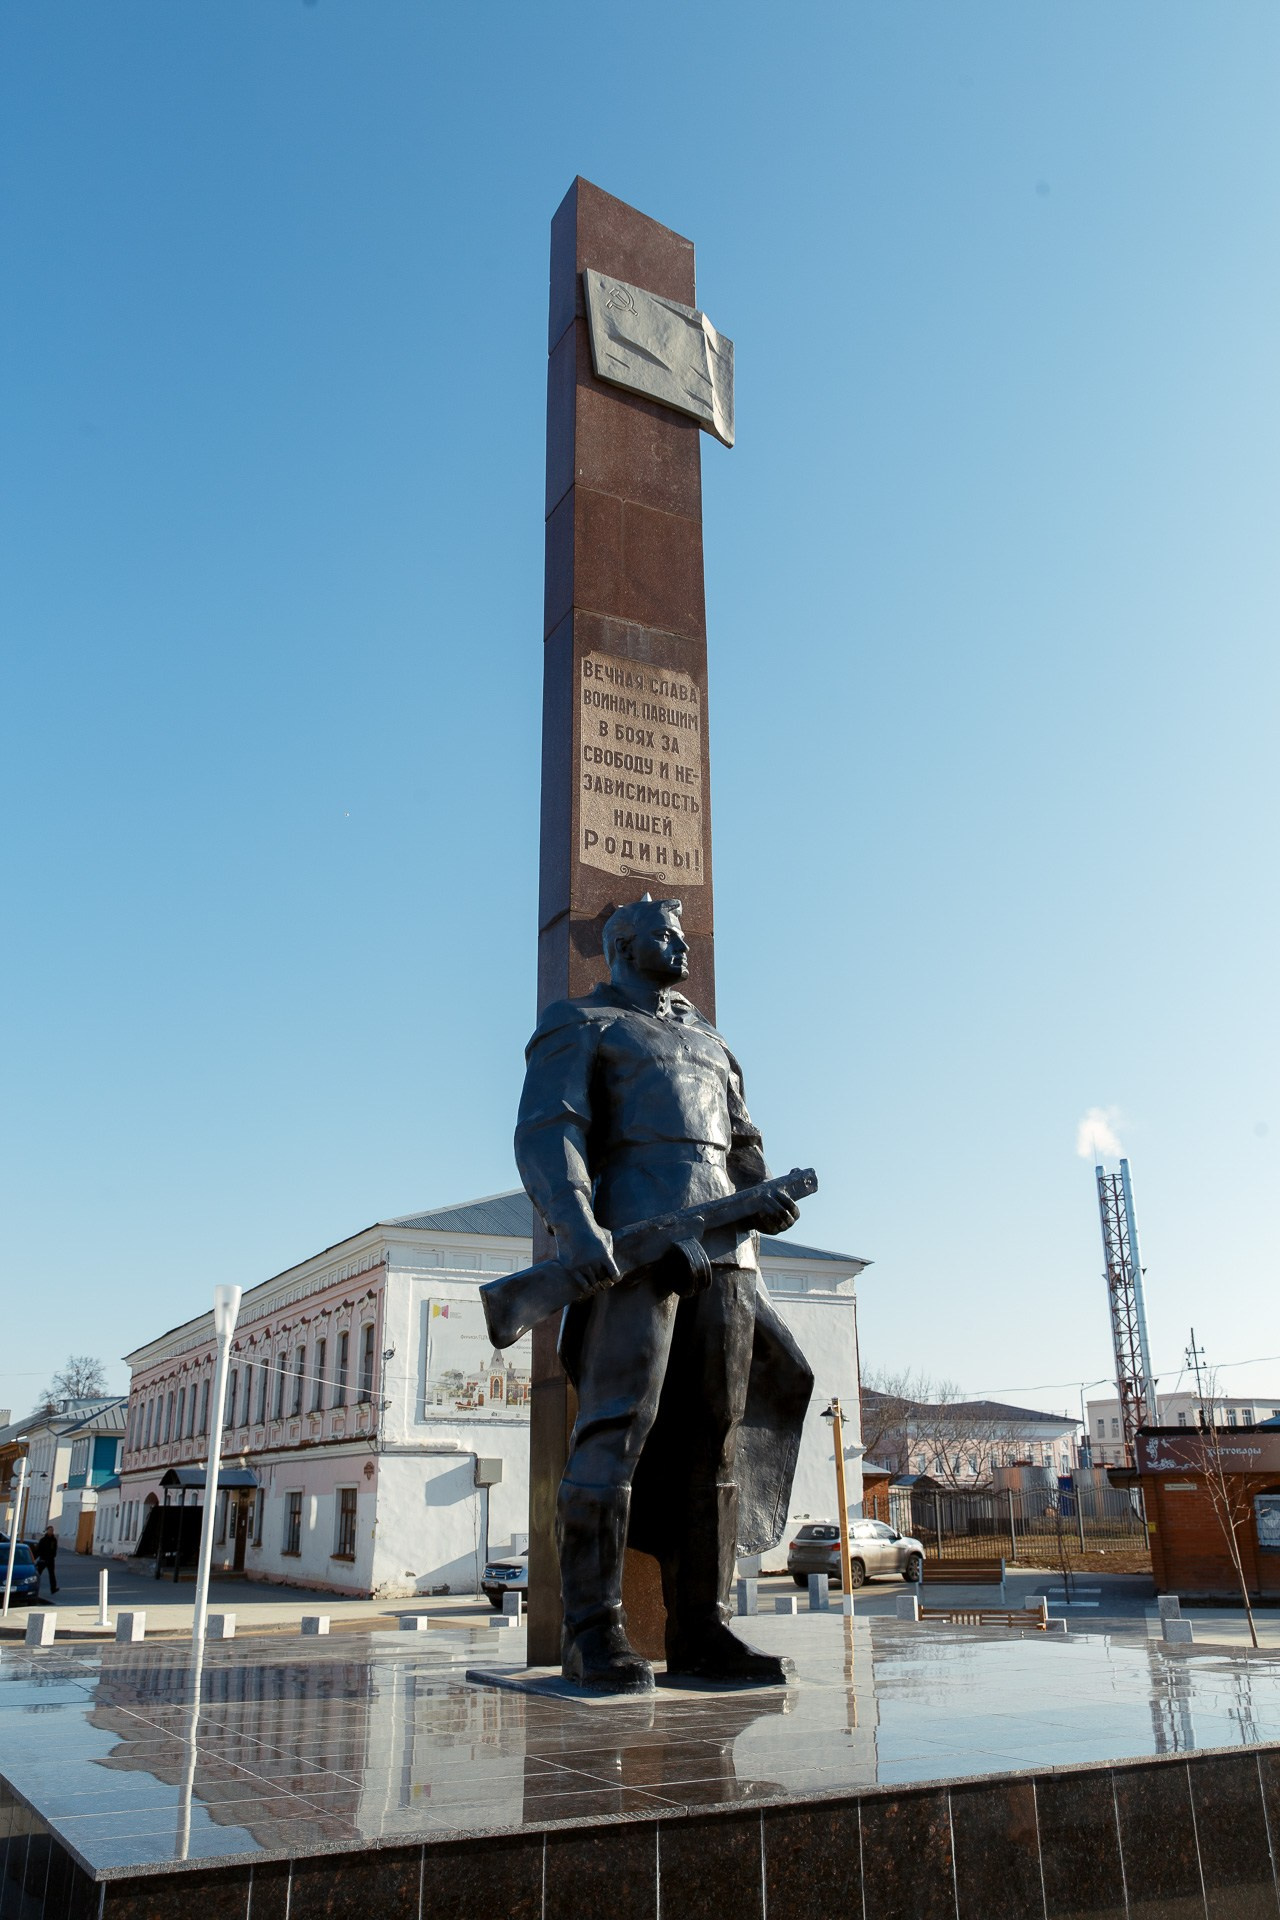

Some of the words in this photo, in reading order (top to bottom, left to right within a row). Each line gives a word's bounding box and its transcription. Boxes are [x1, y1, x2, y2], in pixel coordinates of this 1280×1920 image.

[583, 660, 644, 690] ВЕЧНАЯ
[651, 678, 698, 704] СЛАВА
[583, 688, 640, 718] ВОИНАМ,
[642, 702, 698, 731] ПАВШИМ
[599, 720, 609, 738] В
[615, 723, 655, 749] БОЯХ
[661, 734, 680, 755] ЗА
[583, 745, 653, 776] СВОБОДУ
[659, 761, 669, 781] И
[675, 764, 700, 785] НЕ-
[583, 773, 700, 814] ЗАВИСИМОСТЬ
[613, 808, 672, 837] НАШЕЙ
[584, 828, 700, 871] РОДИНЫ!
